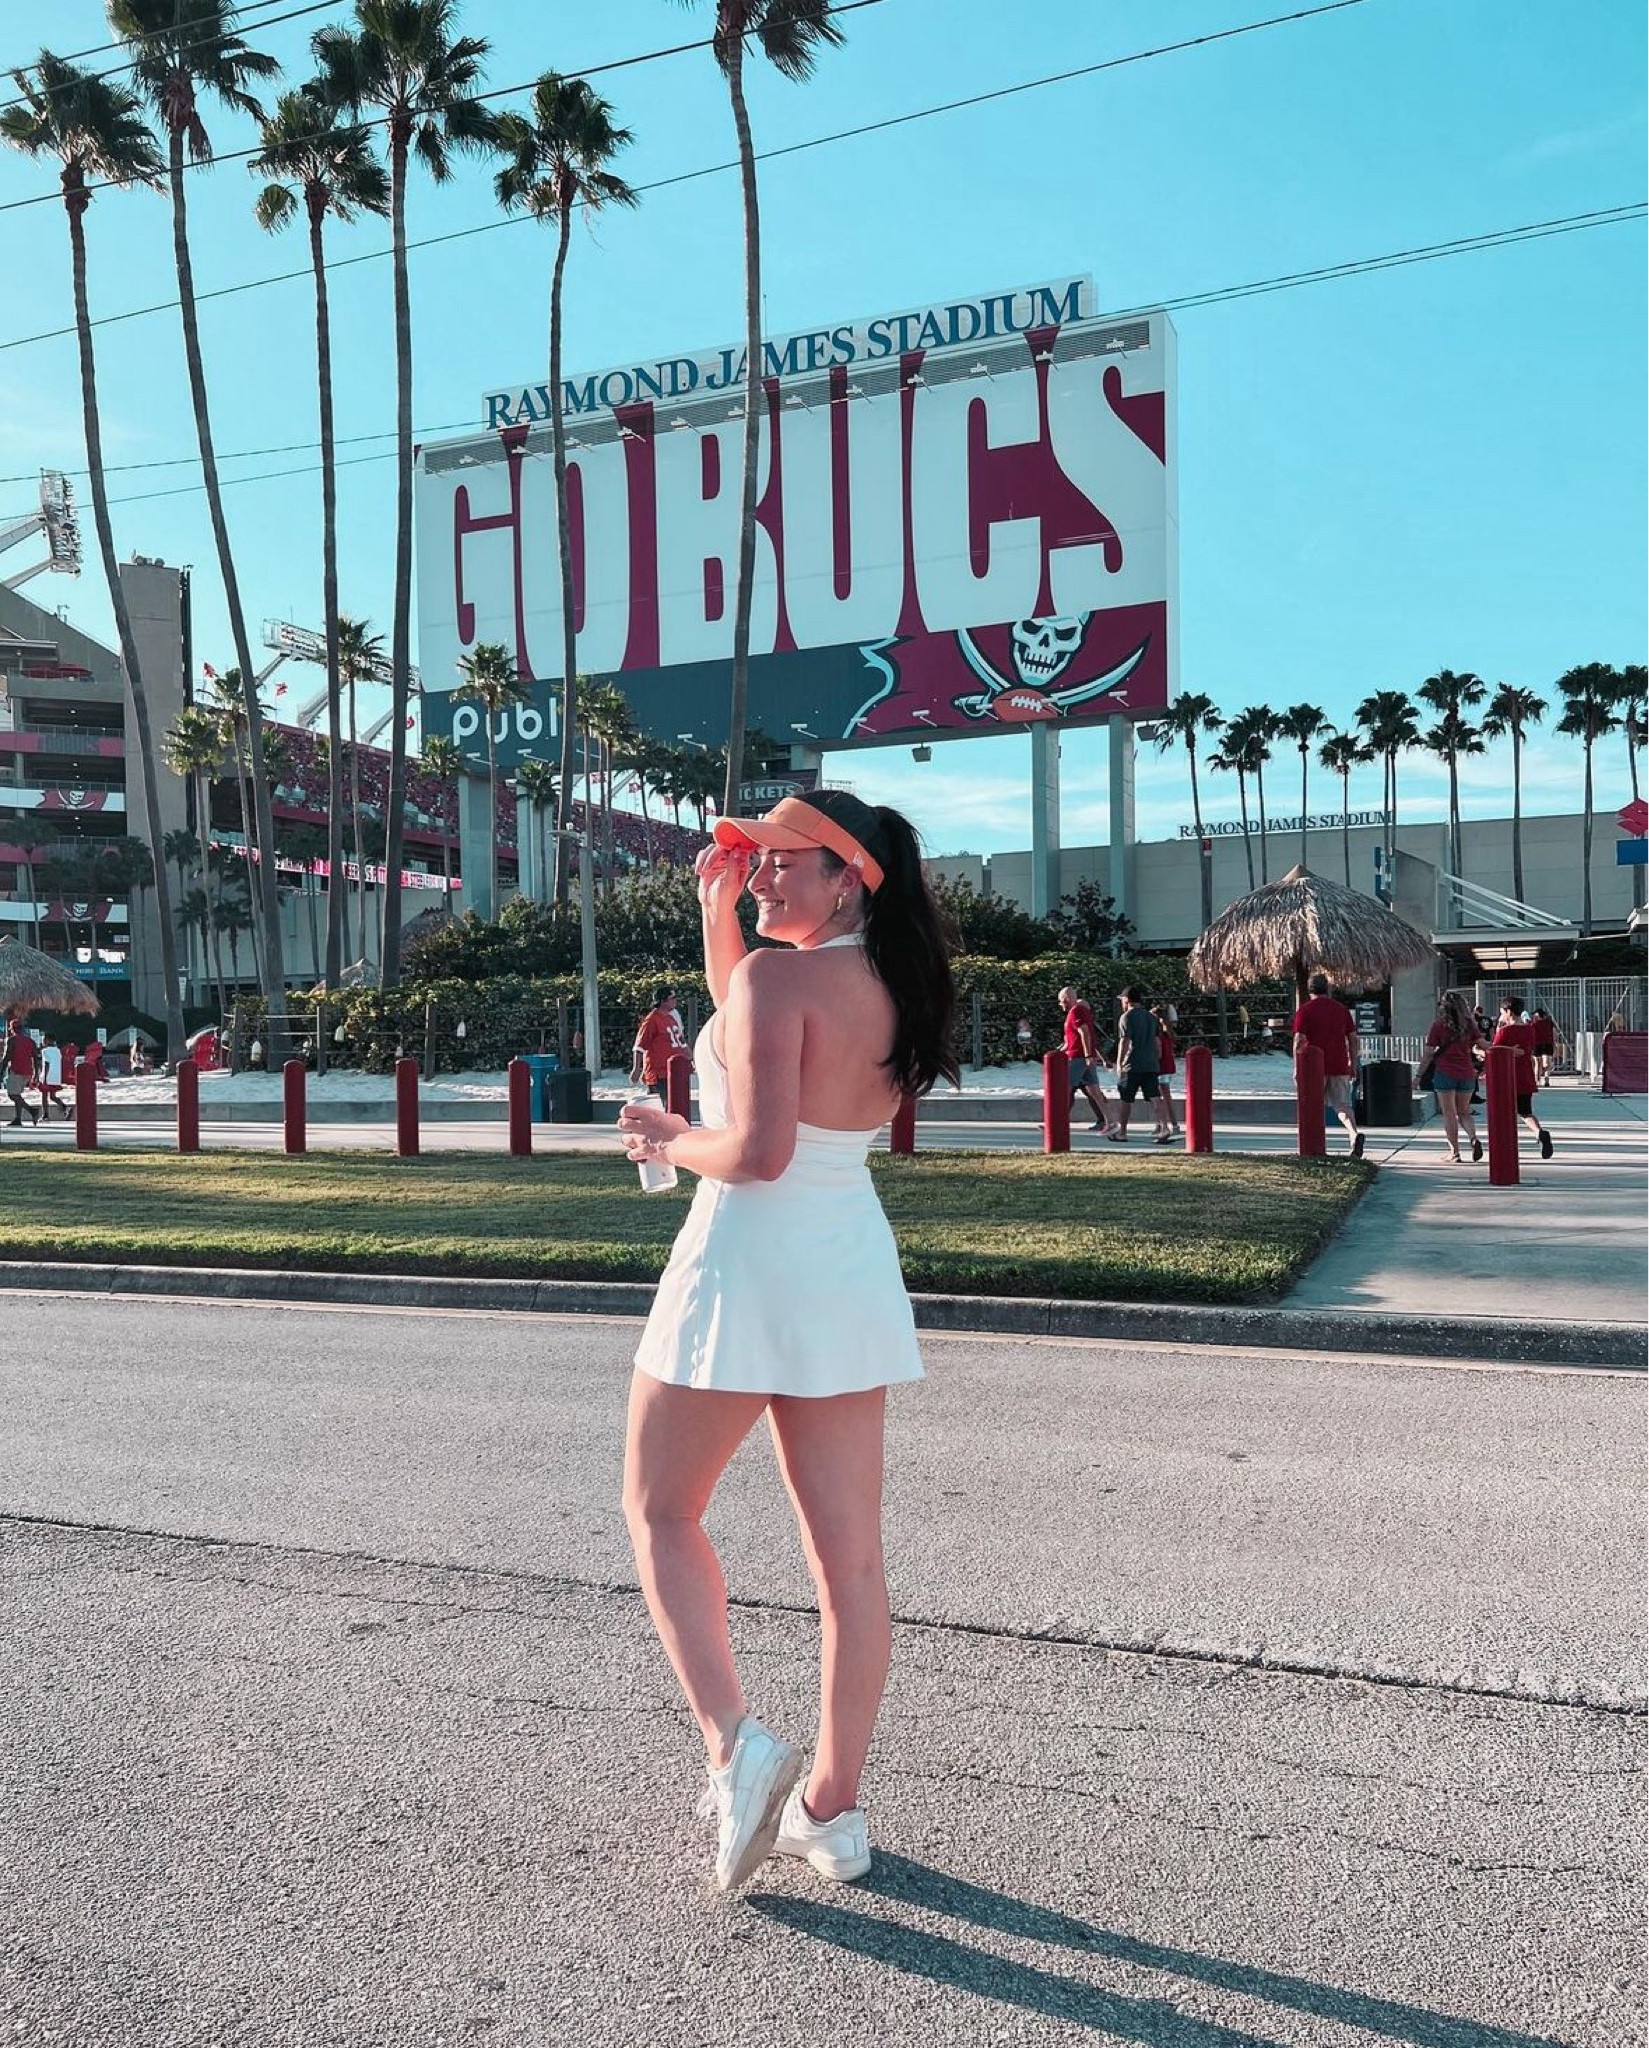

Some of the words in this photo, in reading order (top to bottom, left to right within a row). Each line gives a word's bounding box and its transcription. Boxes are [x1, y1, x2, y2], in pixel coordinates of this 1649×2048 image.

[485, 358, 698, 430] RAYMOND
[867, 280, 1084, 358] STADIUM
[414, 408, 632, 689] GO
[655, 314, 1166, 667] BUCS
[453, 697, 558, 746] publ
[739, 785, 796, 801] ICKETS
[1320, 811, 1392, 828] STADIUM
